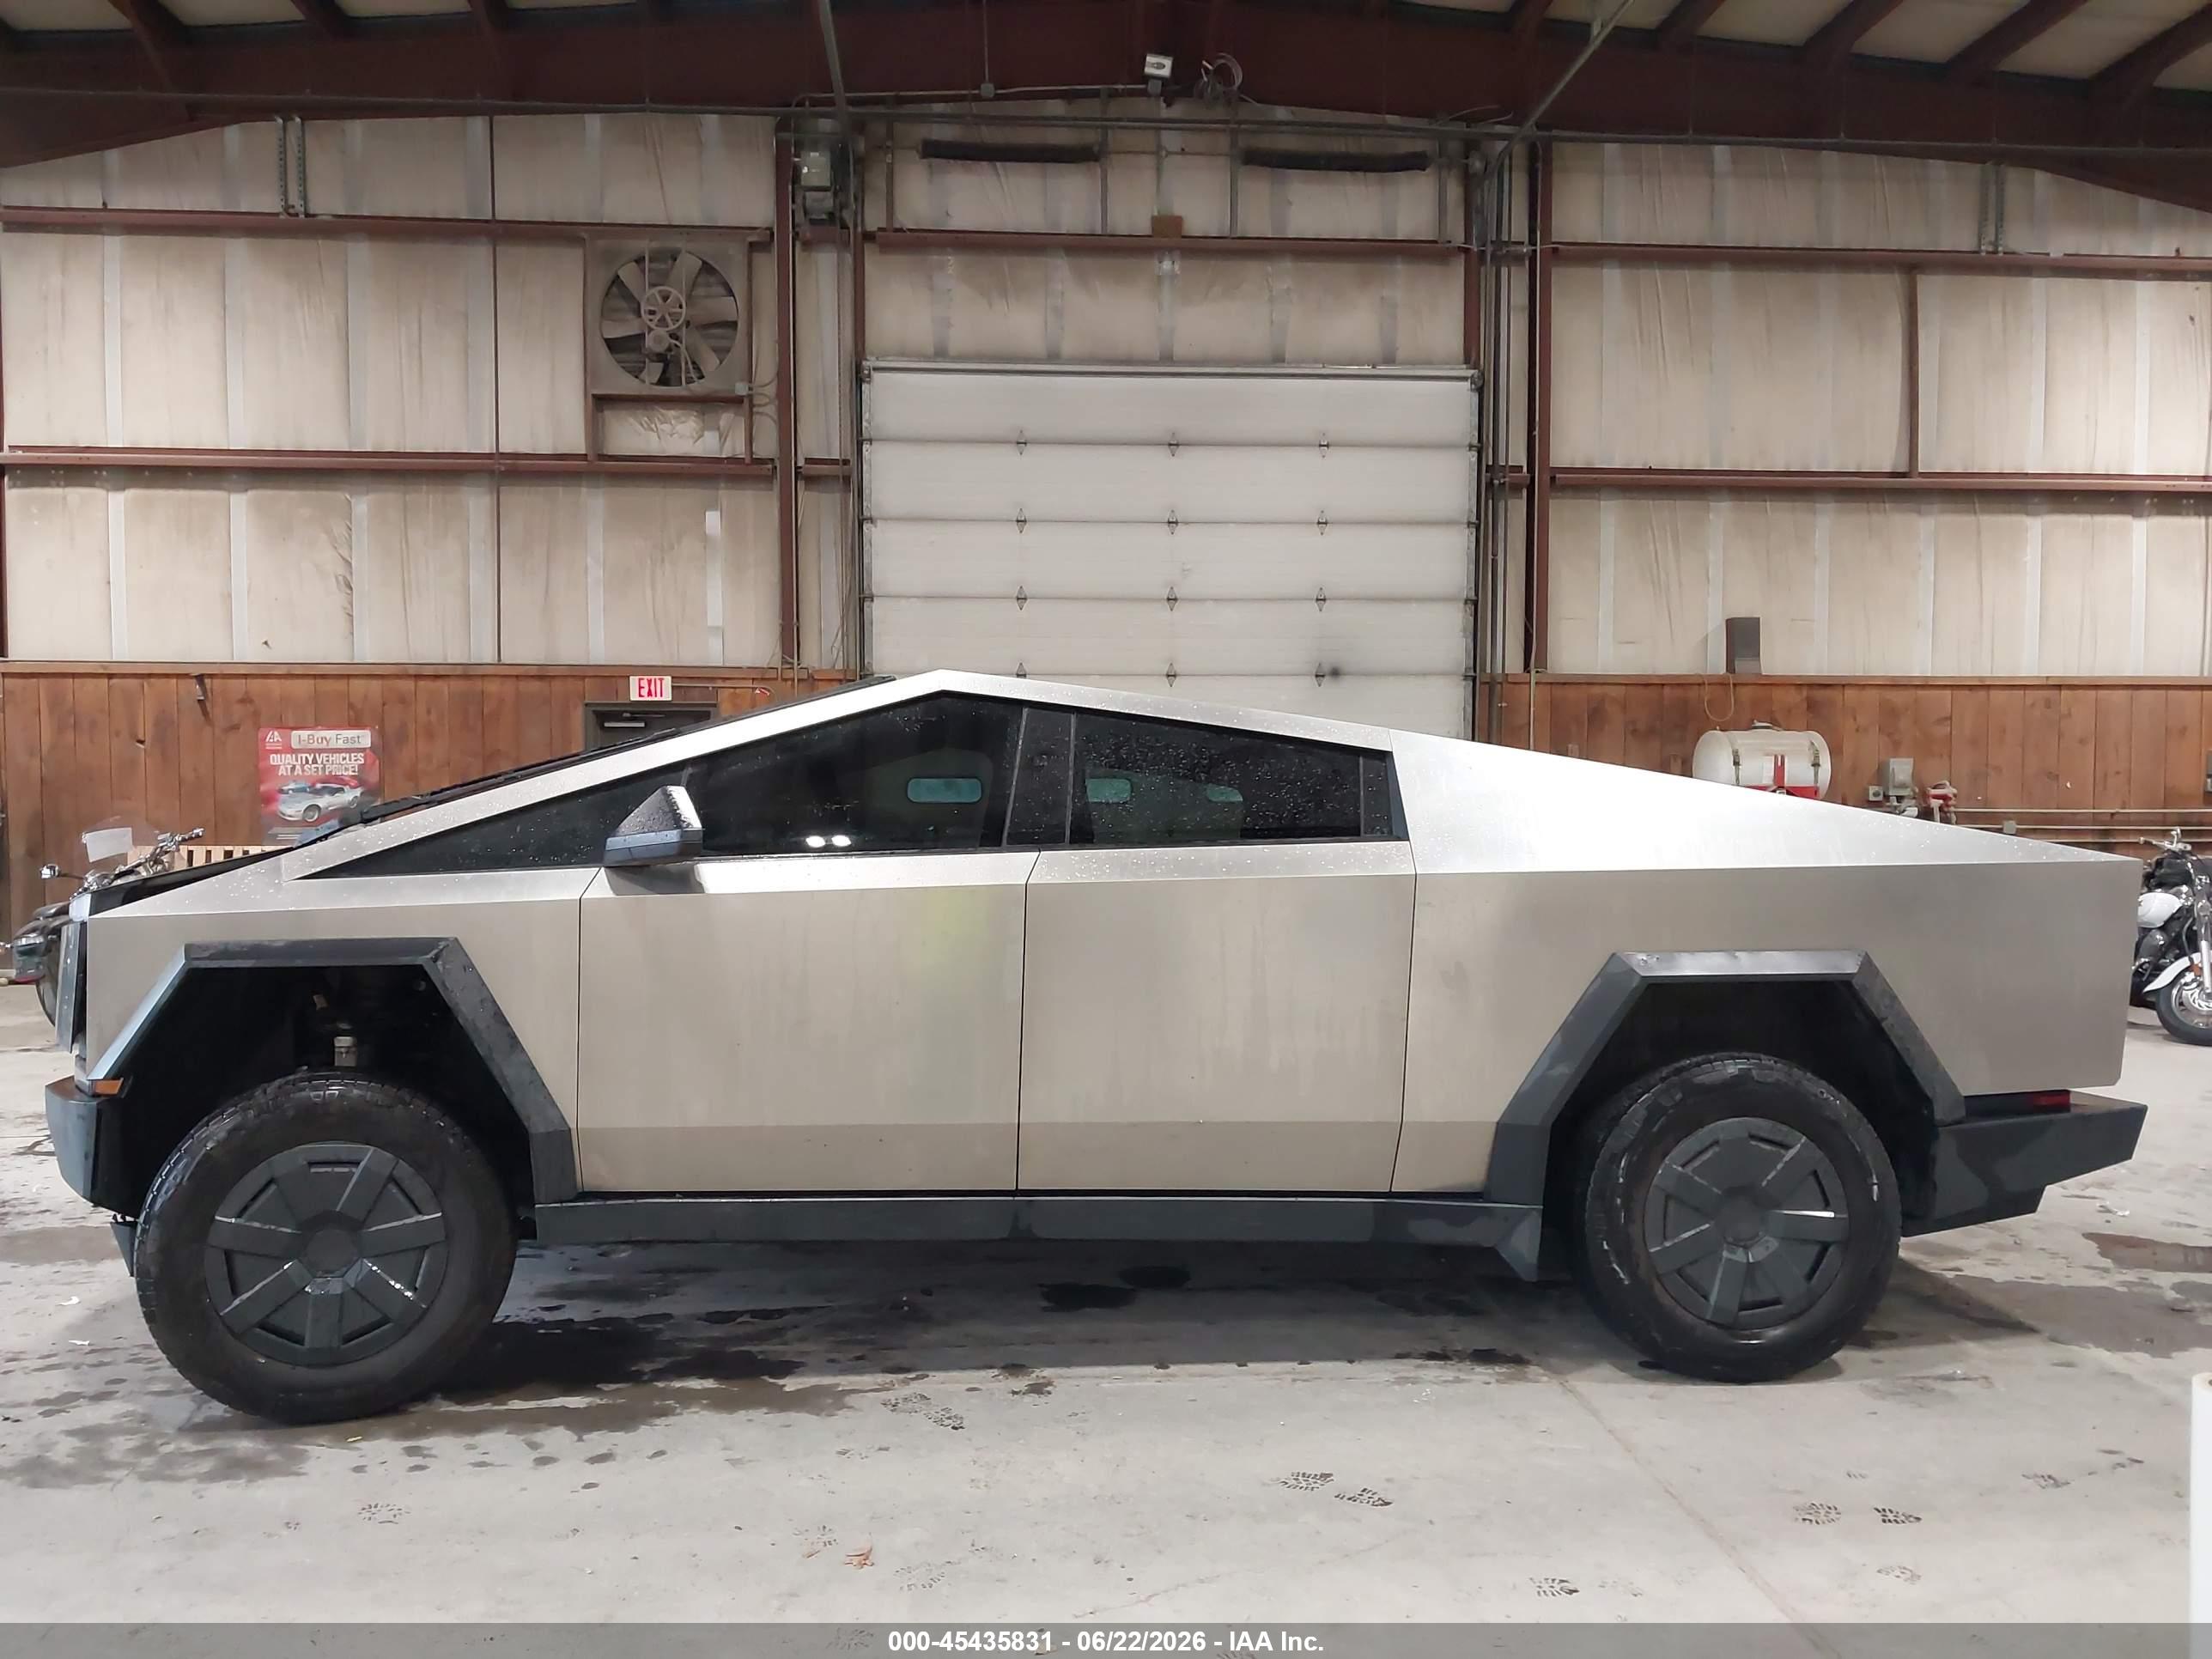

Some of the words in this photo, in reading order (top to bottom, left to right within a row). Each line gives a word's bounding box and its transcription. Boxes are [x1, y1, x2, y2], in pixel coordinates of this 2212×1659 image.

[638, 678, 665, 698] EXIT
[297, 733, 331, 746] I-Buy
[335, 733, 362, 744] Fast
[270, 753, 314, 765] QUALITY
[315, 752, 365, 764] VEHICLES
[278, 764, 294, 776] AT
[294, 764, 303, 776] A
[304, 764, 324, 776] SET
[325, 764, 358, 775] PRICE!
